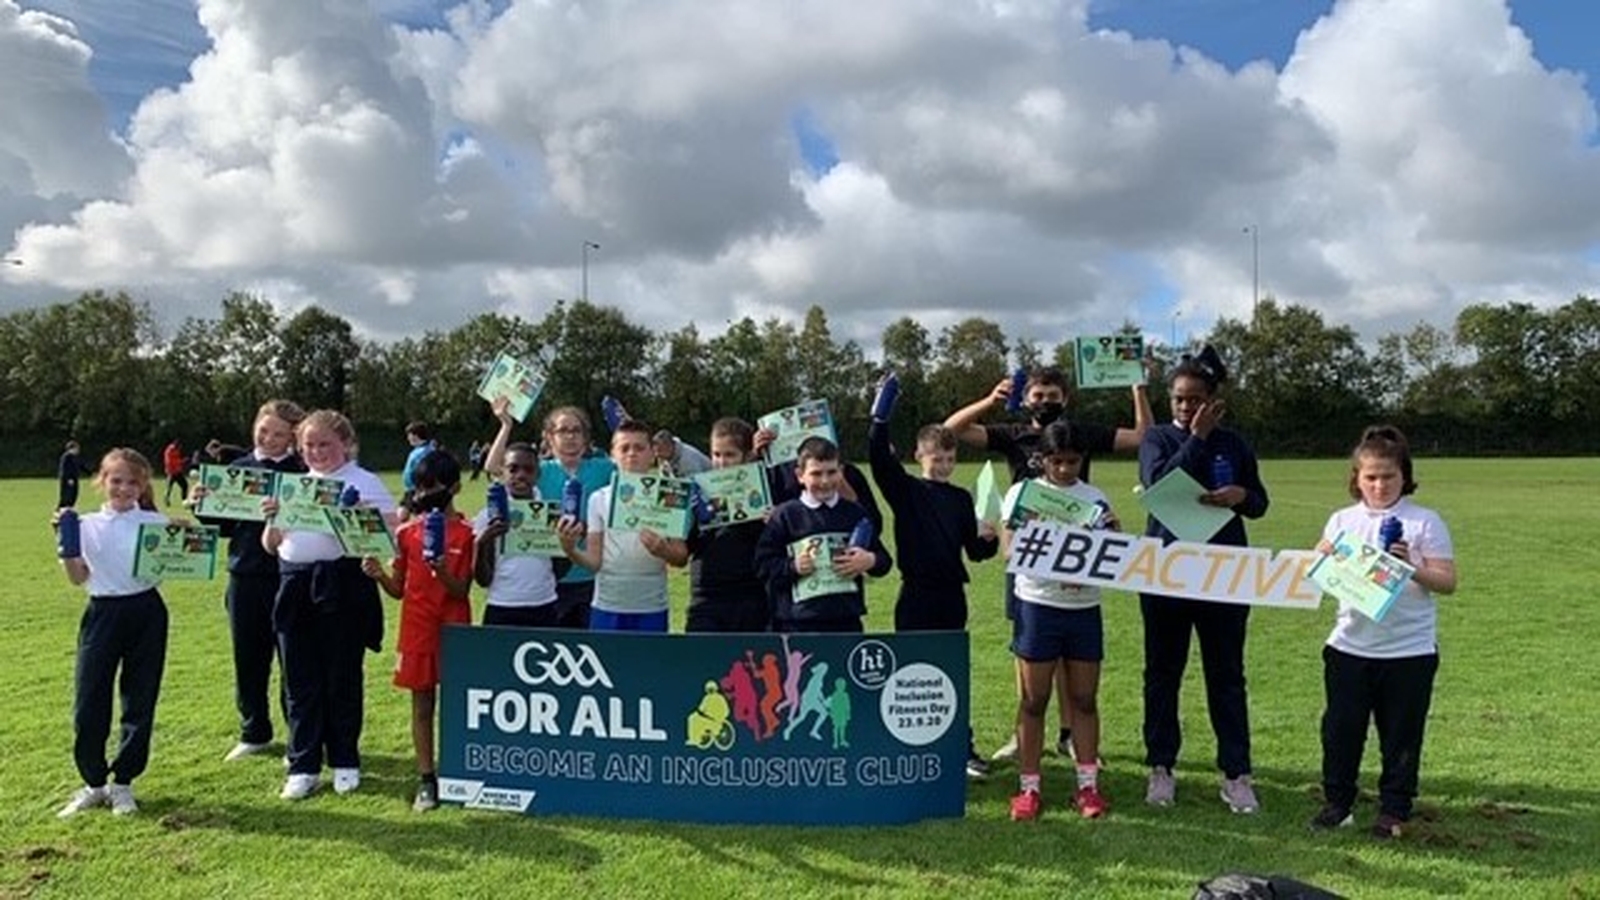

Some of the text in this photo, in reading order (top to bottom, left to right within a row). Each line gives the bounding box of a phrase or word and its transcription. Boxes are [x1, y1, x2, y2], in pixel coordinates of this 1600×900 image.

[860, 648, 885, 671] hi
[895, 678, 943, 687] National
[894, 691, 945, 701] Inclusion
[467, 688, 668, 741] FOR ALL
[888, 703, 950, 715] Fitness Day
[464, 743, 941, 787] BECOME AN INCLUSIVE CLUB
